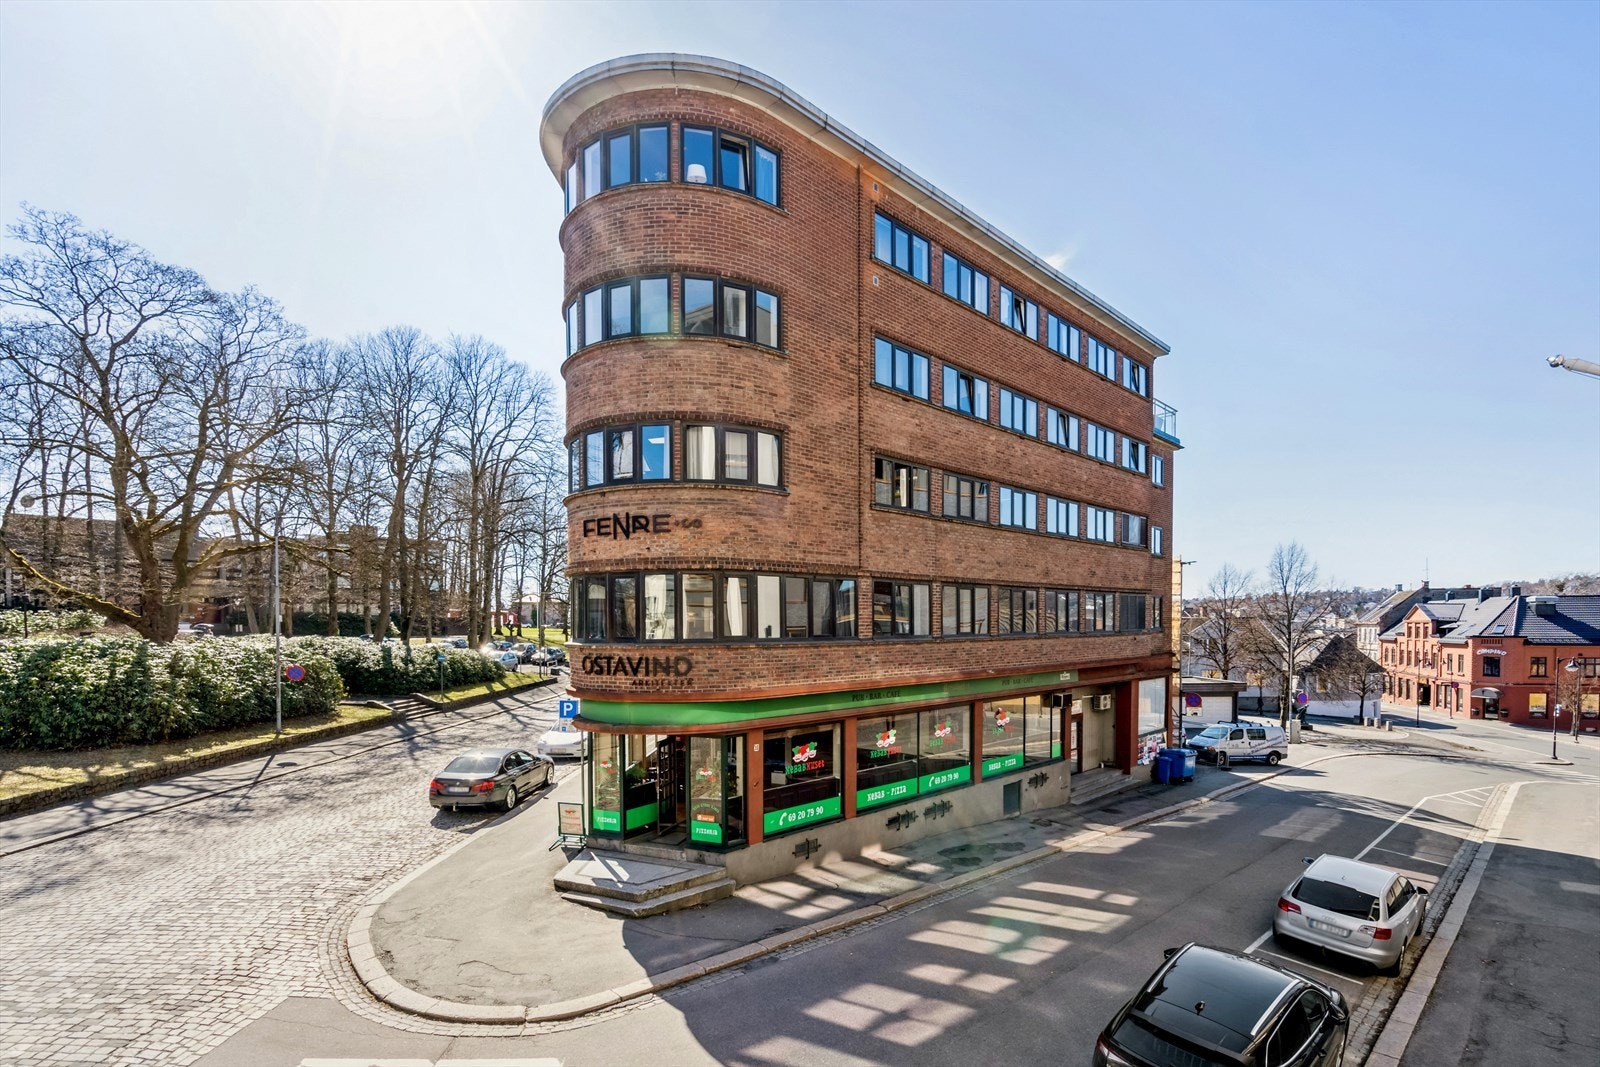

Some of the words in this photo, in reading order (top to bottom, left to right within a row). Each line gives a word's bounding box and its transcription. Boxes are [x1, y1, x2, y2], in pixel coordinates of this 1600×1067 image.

[563, 702, 574, 717] P
[788, 812, 796, 822] 69
[797, 811, 806, 820] 20
[806, 808, 815, 817] 79
[815, 806, 824, 815] 90
